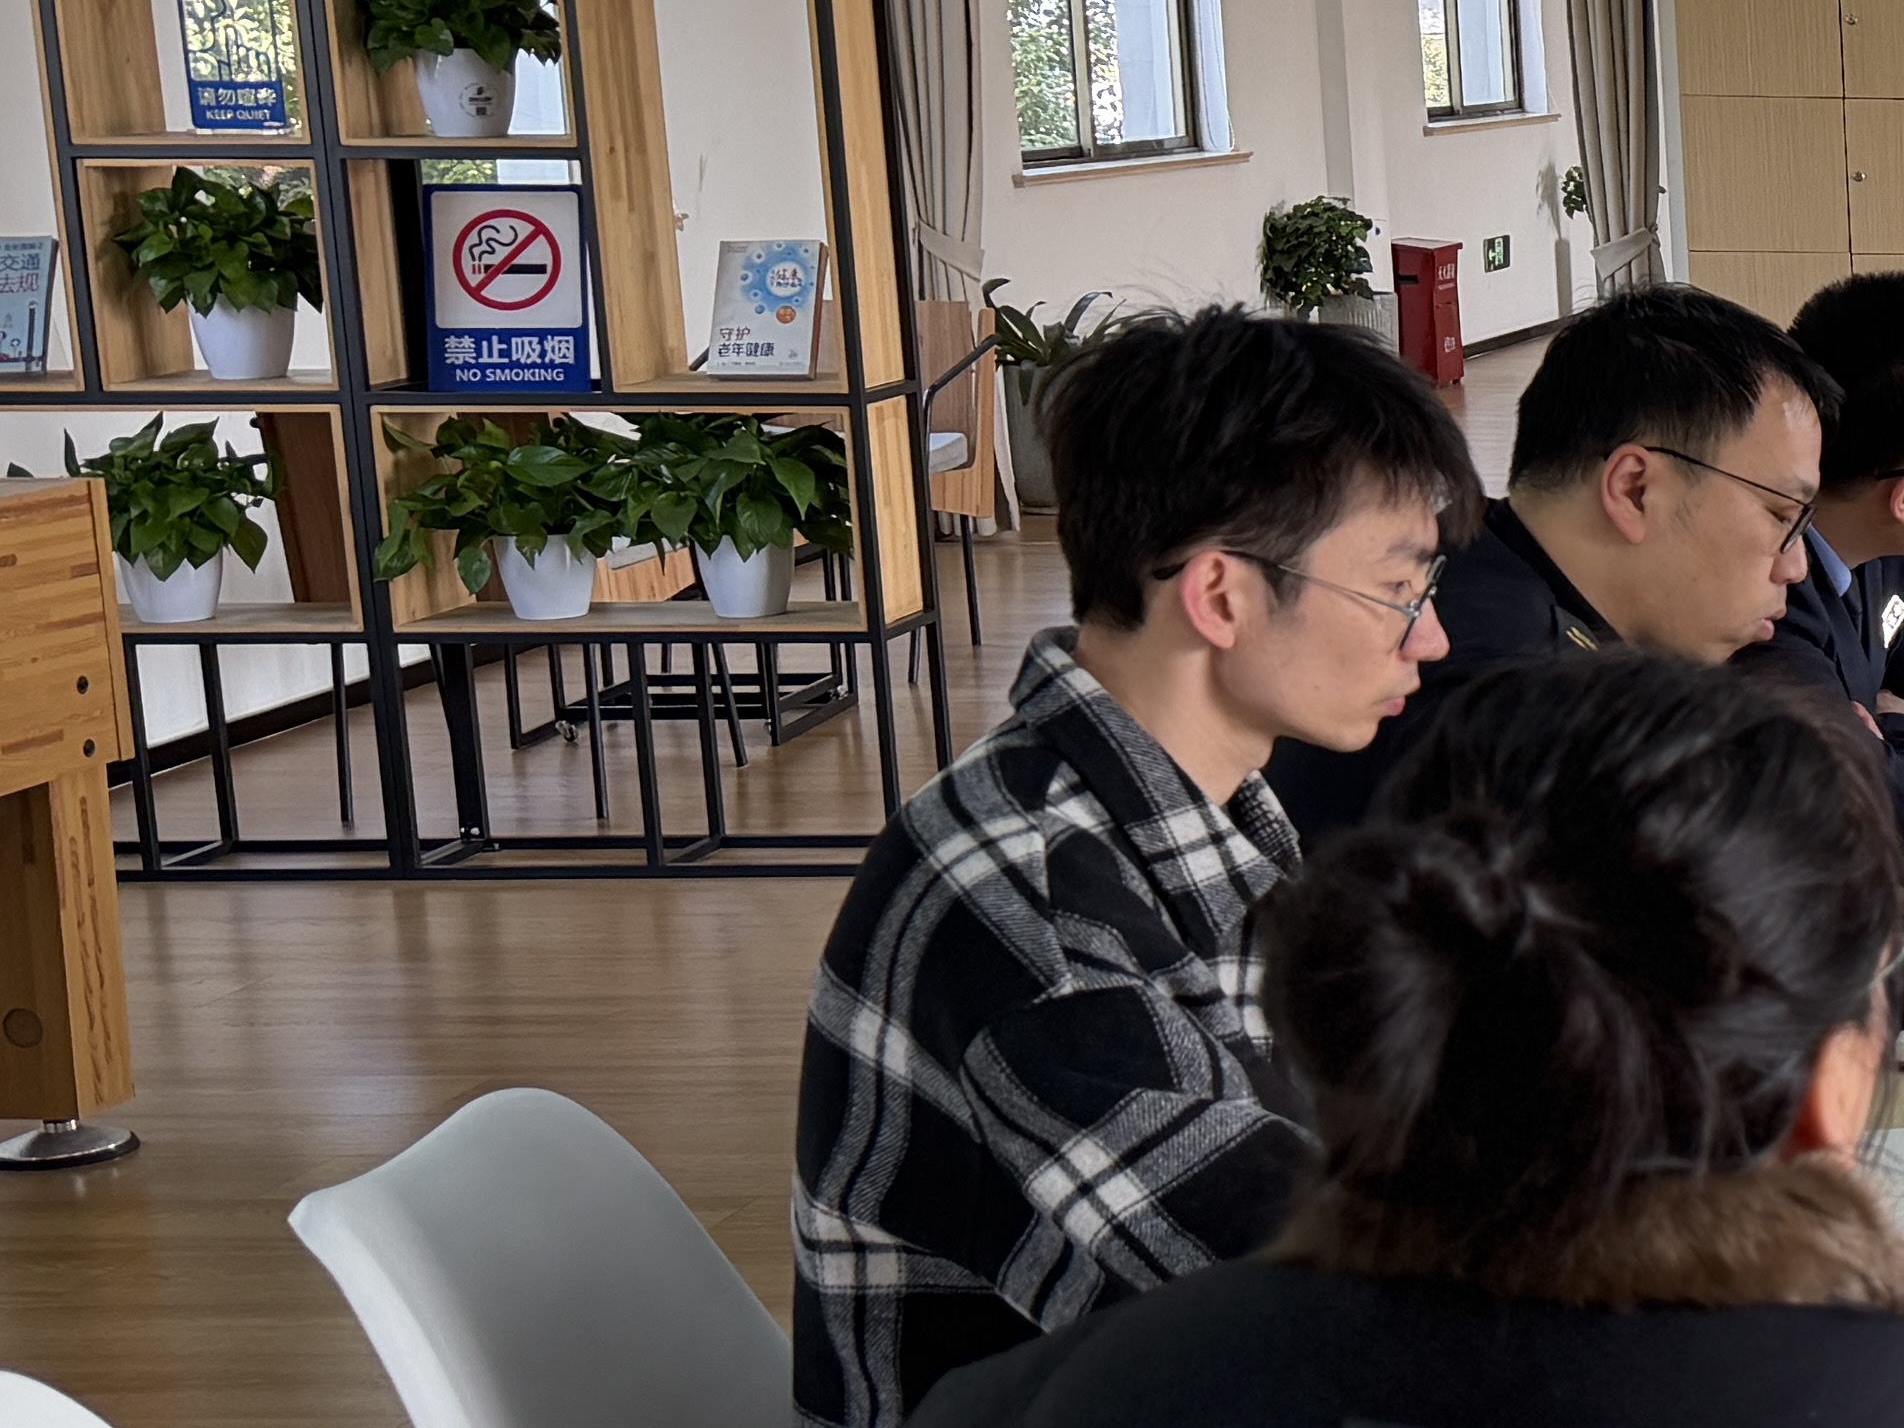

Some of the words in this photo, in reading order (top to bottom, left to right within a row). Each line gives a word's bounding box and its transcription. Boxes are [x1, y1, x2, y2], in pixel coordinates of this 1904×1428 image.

[206, 109, 233, 120] KEEP
[236, 109, 271, 120] QUIET
[0, 253, 40, 272] 交通
[719, 326, 751, 341] 守护
[444, 334, 576, 365] 禁止吸烟
[718, 342, 775, 358] 老年健康
[455, 368, 482, 382] NO
[485, 368, 565, 382] SMOKING
